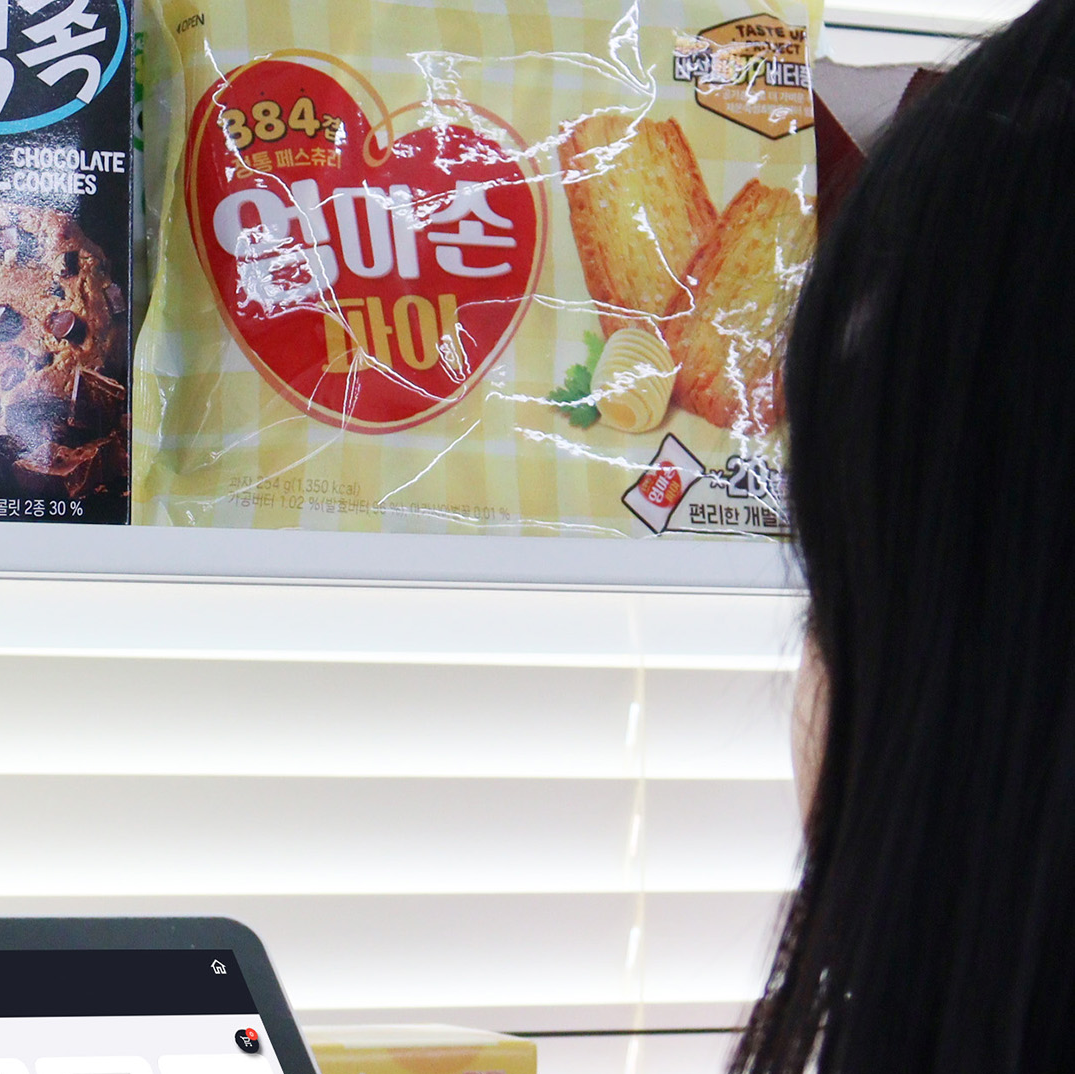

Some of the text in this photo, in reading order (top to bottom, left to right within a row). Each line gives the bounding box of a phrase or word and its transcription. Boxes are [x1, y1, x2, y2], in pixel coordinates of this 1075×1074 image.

[181, 13, 205, 31] OPEN
[735, 25, 785, 38] TASTE
[13, 148, 125, 173] CHOCOLATE
[12, 168, 98, 196] COOKIES
[212, 177, 518, 303] 엄마손
[322, 293, 465, 380] 파이
[24, 501, 46, 517] 2종
[49, 502, 67, 517] 30
[689, 503, 740, 526] 편리한
